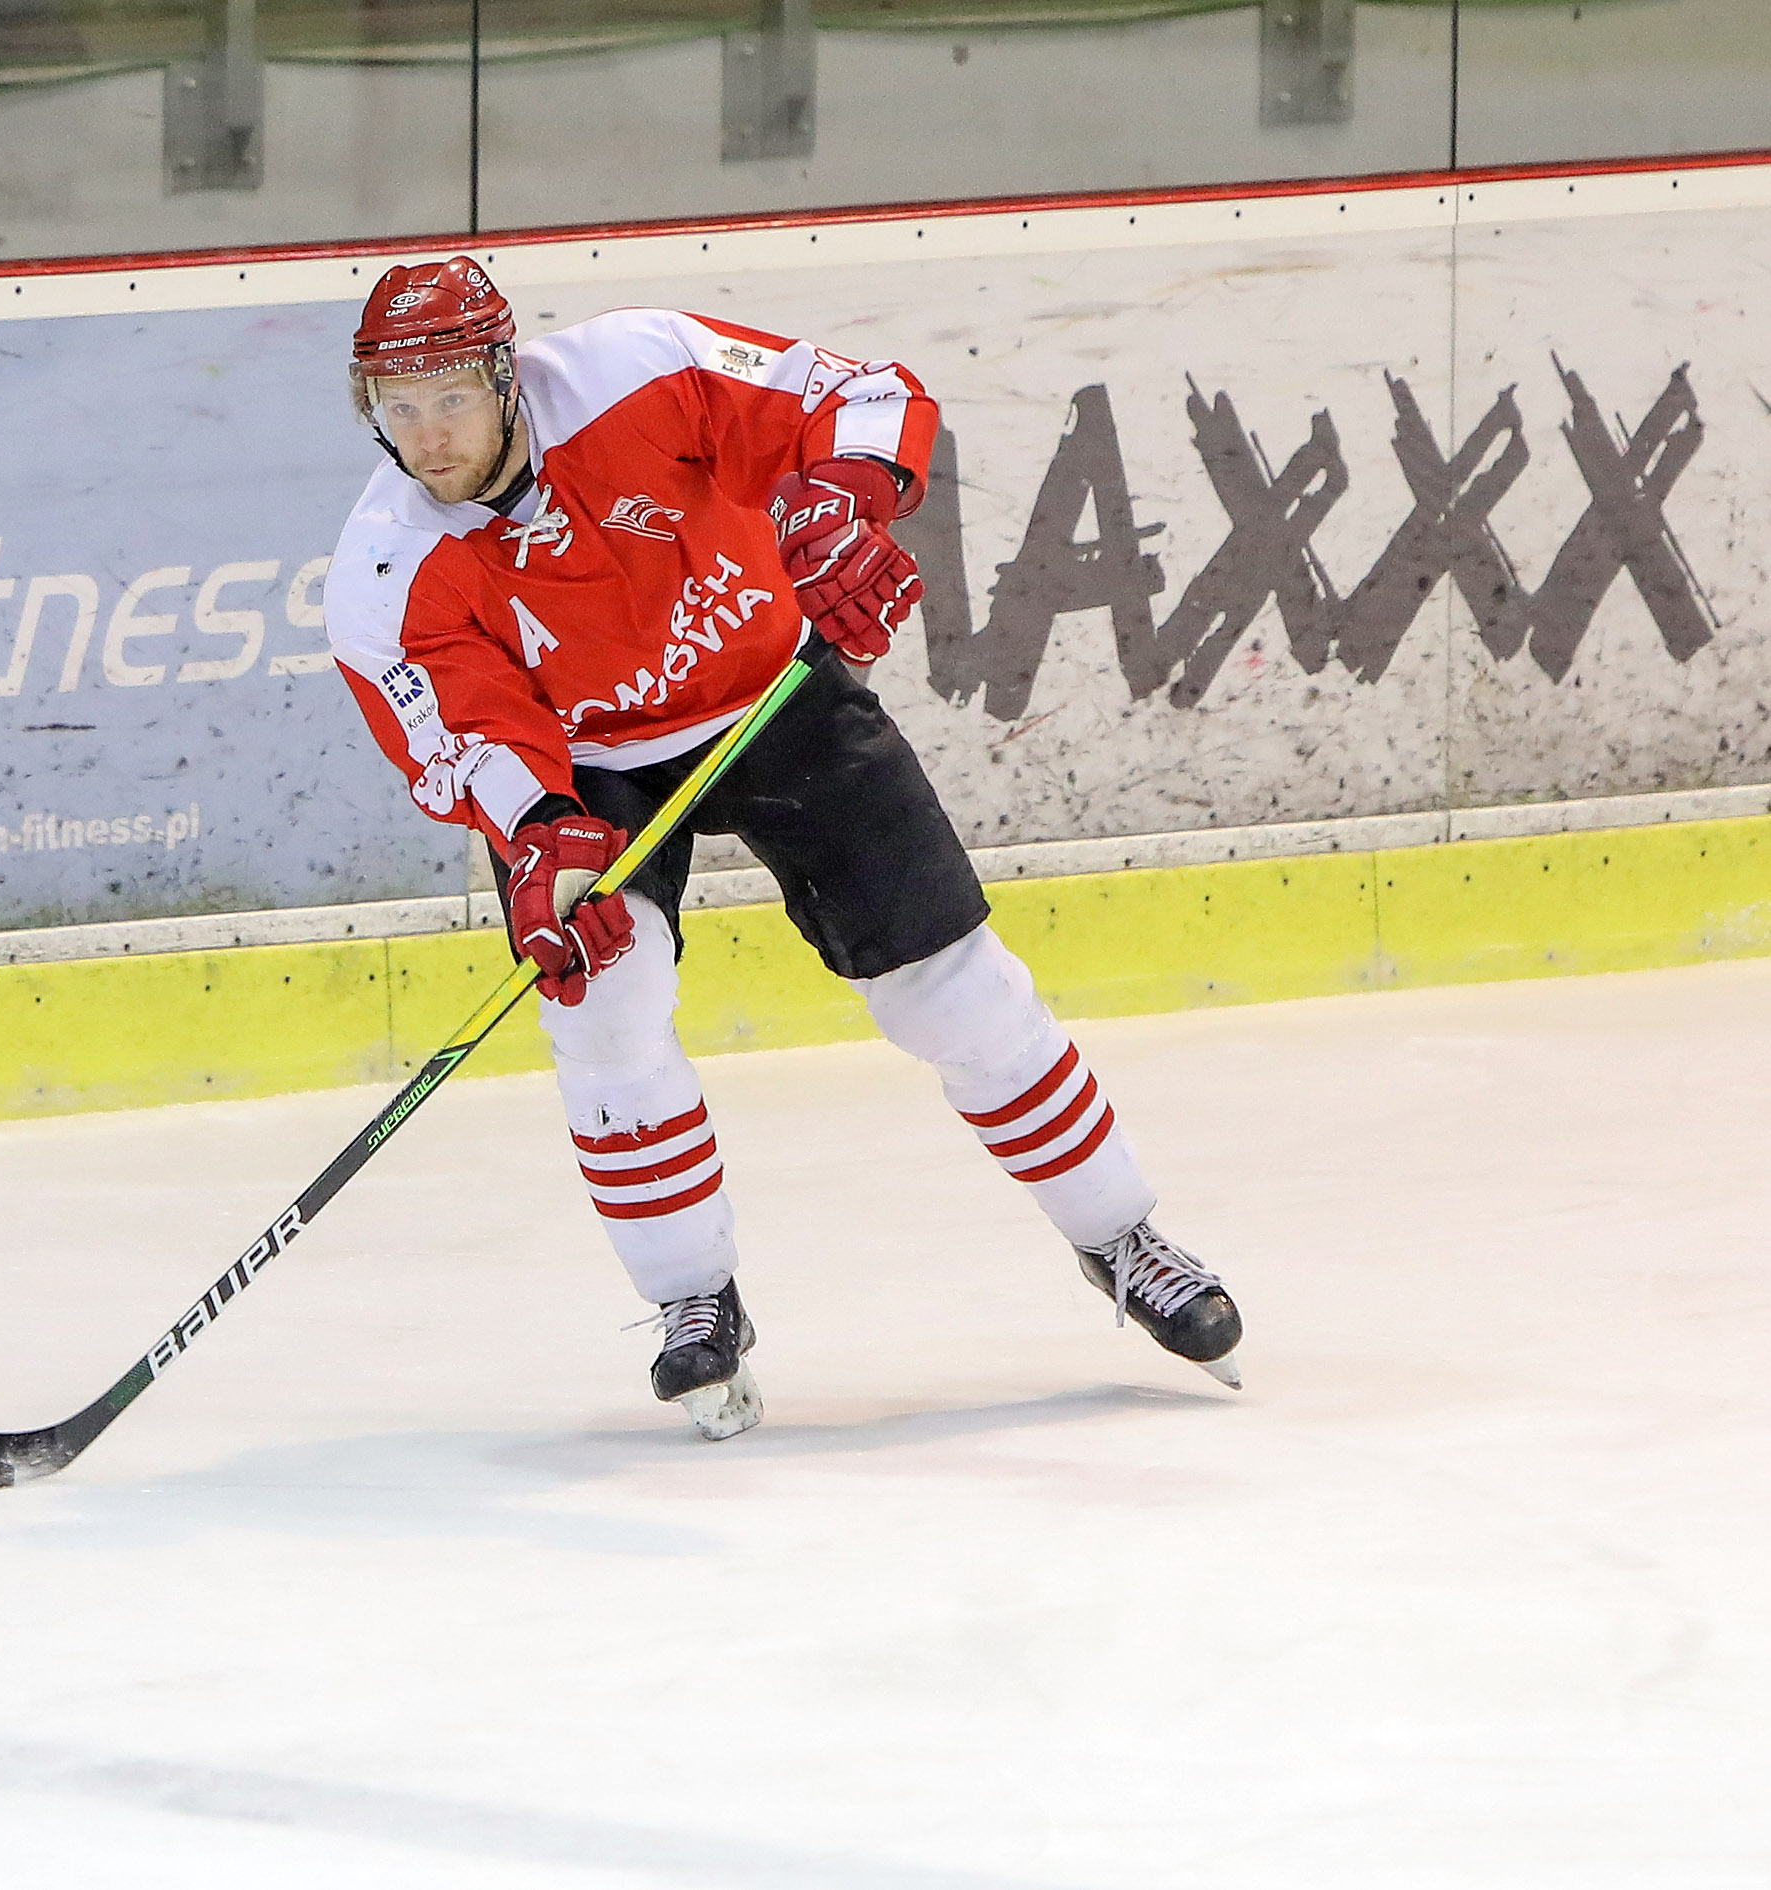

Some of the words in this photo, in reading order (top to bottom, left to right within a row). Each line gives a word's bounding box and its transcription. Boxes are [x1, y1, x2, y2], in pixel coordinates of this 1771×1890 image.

[377, 336, 428, 351] BAUER
[508, 596, 560, 669] A
[559, 826, 605, 841] BAUER
[147, 1204, 307, 1379] BAUER
